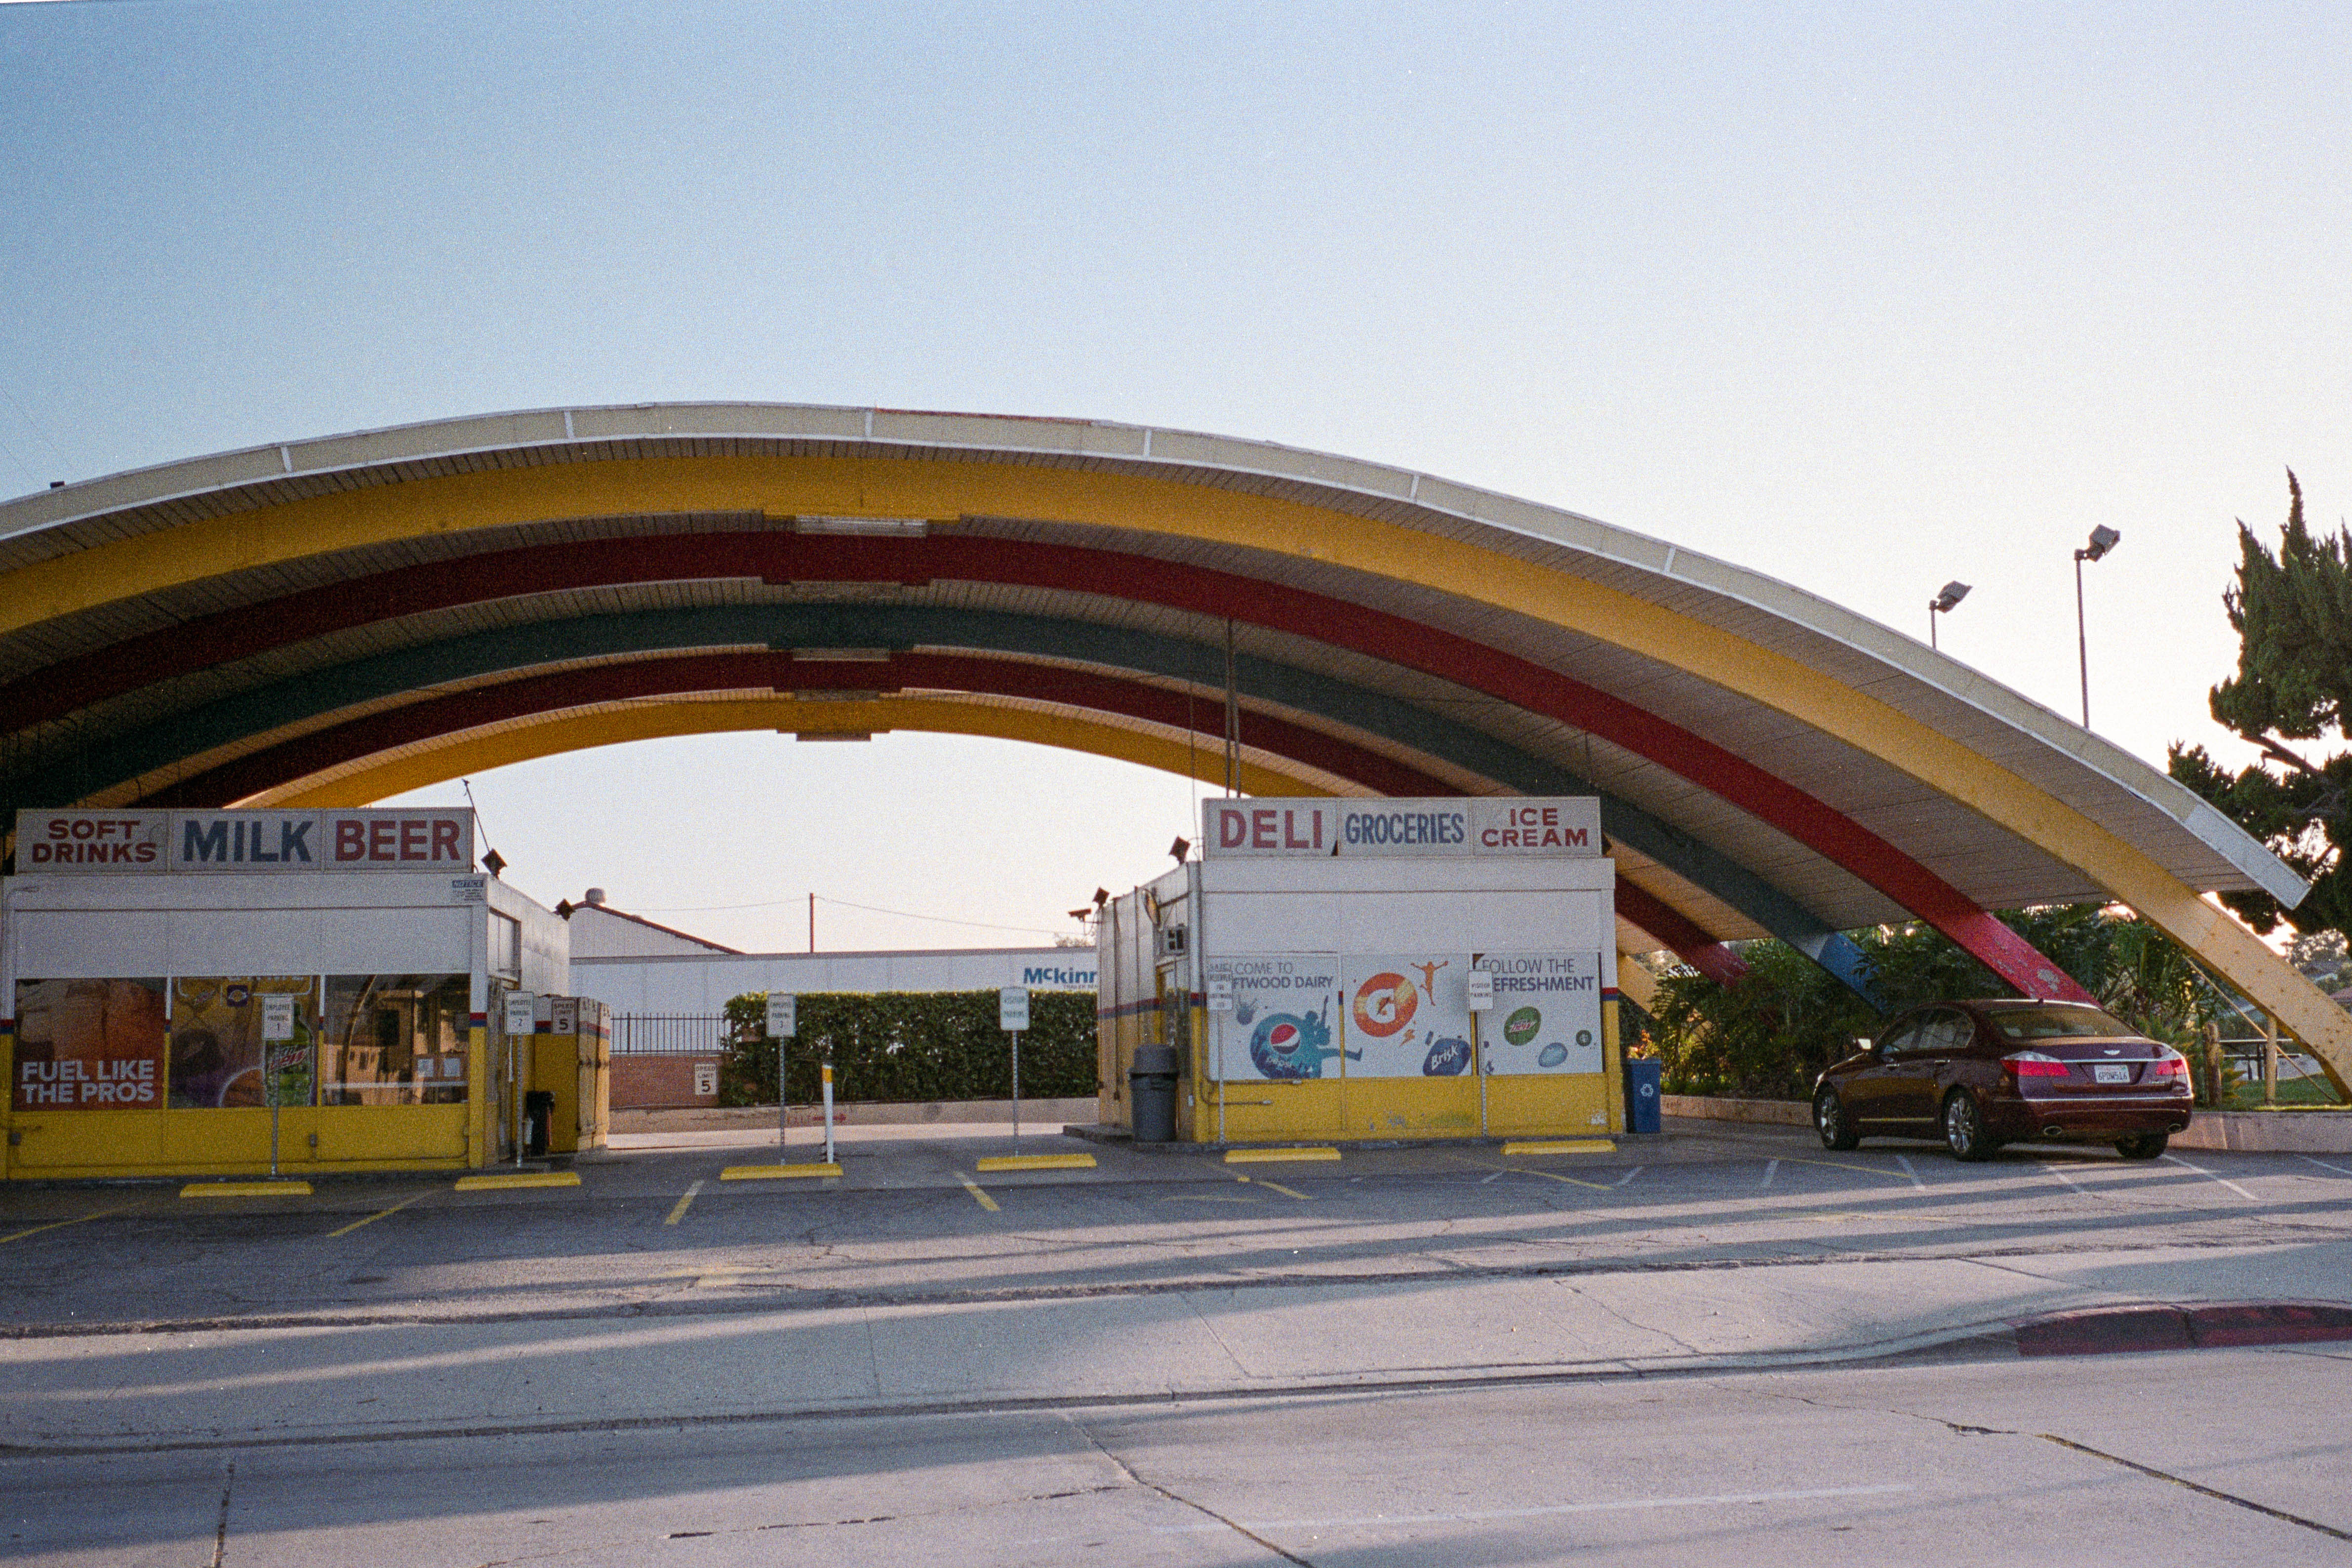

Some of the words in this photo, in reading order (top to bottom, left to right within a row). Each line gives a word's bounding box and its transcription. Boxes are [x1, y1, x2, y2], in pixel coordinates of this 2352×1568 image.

[1510, 808, 1558, 827] ICE
[48, 819, 141, 840] SOFT
[1220, 809, 1322, 849] DELI
[1345, 813, 1465, 845] GROCERIES
[1481, 829, 1588, 848] CREAM
[183, 820, 314, 862] MILK
[335, 820, 460, 861] BEER
[32, 842, 157, 863] DRINKS
[1278, 962, 1293, 974] TO
[1482, 959, 1542, 973] FOLLOW
[1548, 959, 1575, 973] THE
[1295, 976, 1333, 988] DAIRY
[1493, 976, 1595, 992] EFRESHMENT
[277, 1023, 280, 1032] 1
[518, 1018, 522, 1027] 2
[559, 1018, 568, 1030] 5
[22, 1061, 90, 1082] FUEL
[97, 1060, 155, 1080] LIKE
[21, 1083, 74, 1103] THE
[81, 1082, 155, 1102] PROS
[701, 1080, 711, 1092] 5
